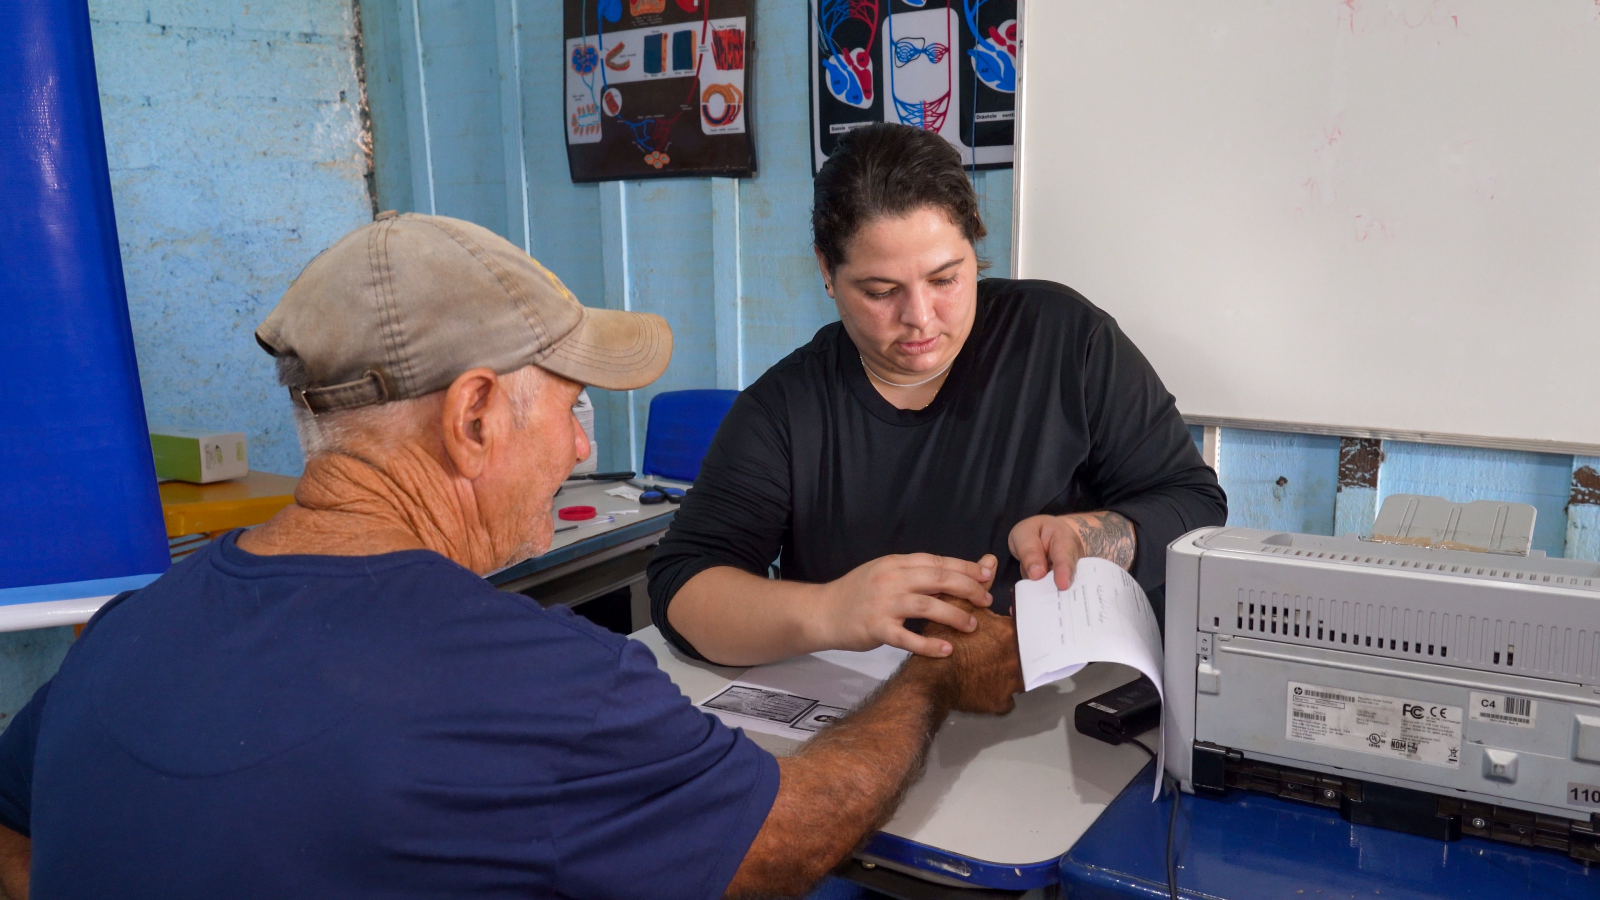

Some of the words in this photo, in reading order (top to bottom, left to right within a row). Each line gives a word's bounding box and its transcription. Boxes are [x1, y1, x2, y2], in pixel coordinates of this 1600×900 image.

[1481, 699, 1496, 708] C4
[1430, 707, 1447, 719] CE
[1391, 740, 1406, 750] NOM
